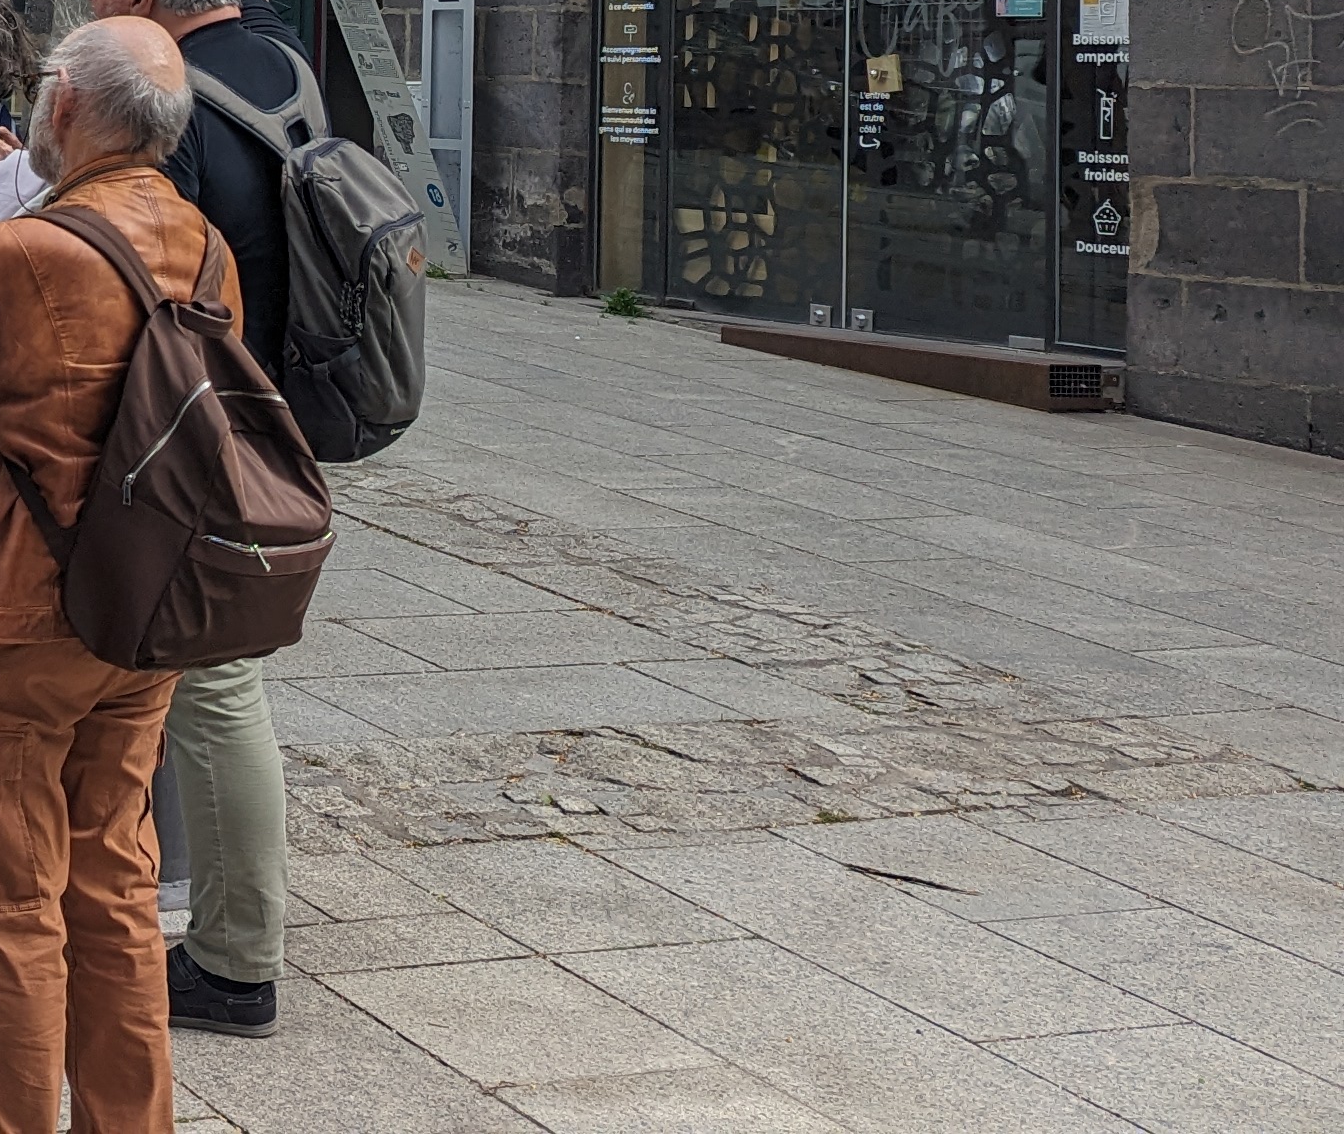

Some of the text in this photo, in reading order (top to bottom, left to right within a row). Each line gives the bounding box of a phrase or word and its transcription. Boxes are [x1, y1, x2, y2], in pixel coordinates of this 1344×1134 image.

[1073, 33, 1131, 46] Boissons
[1084, 168, 1130, 182] froides
[428, 188, 443, 204] 18
